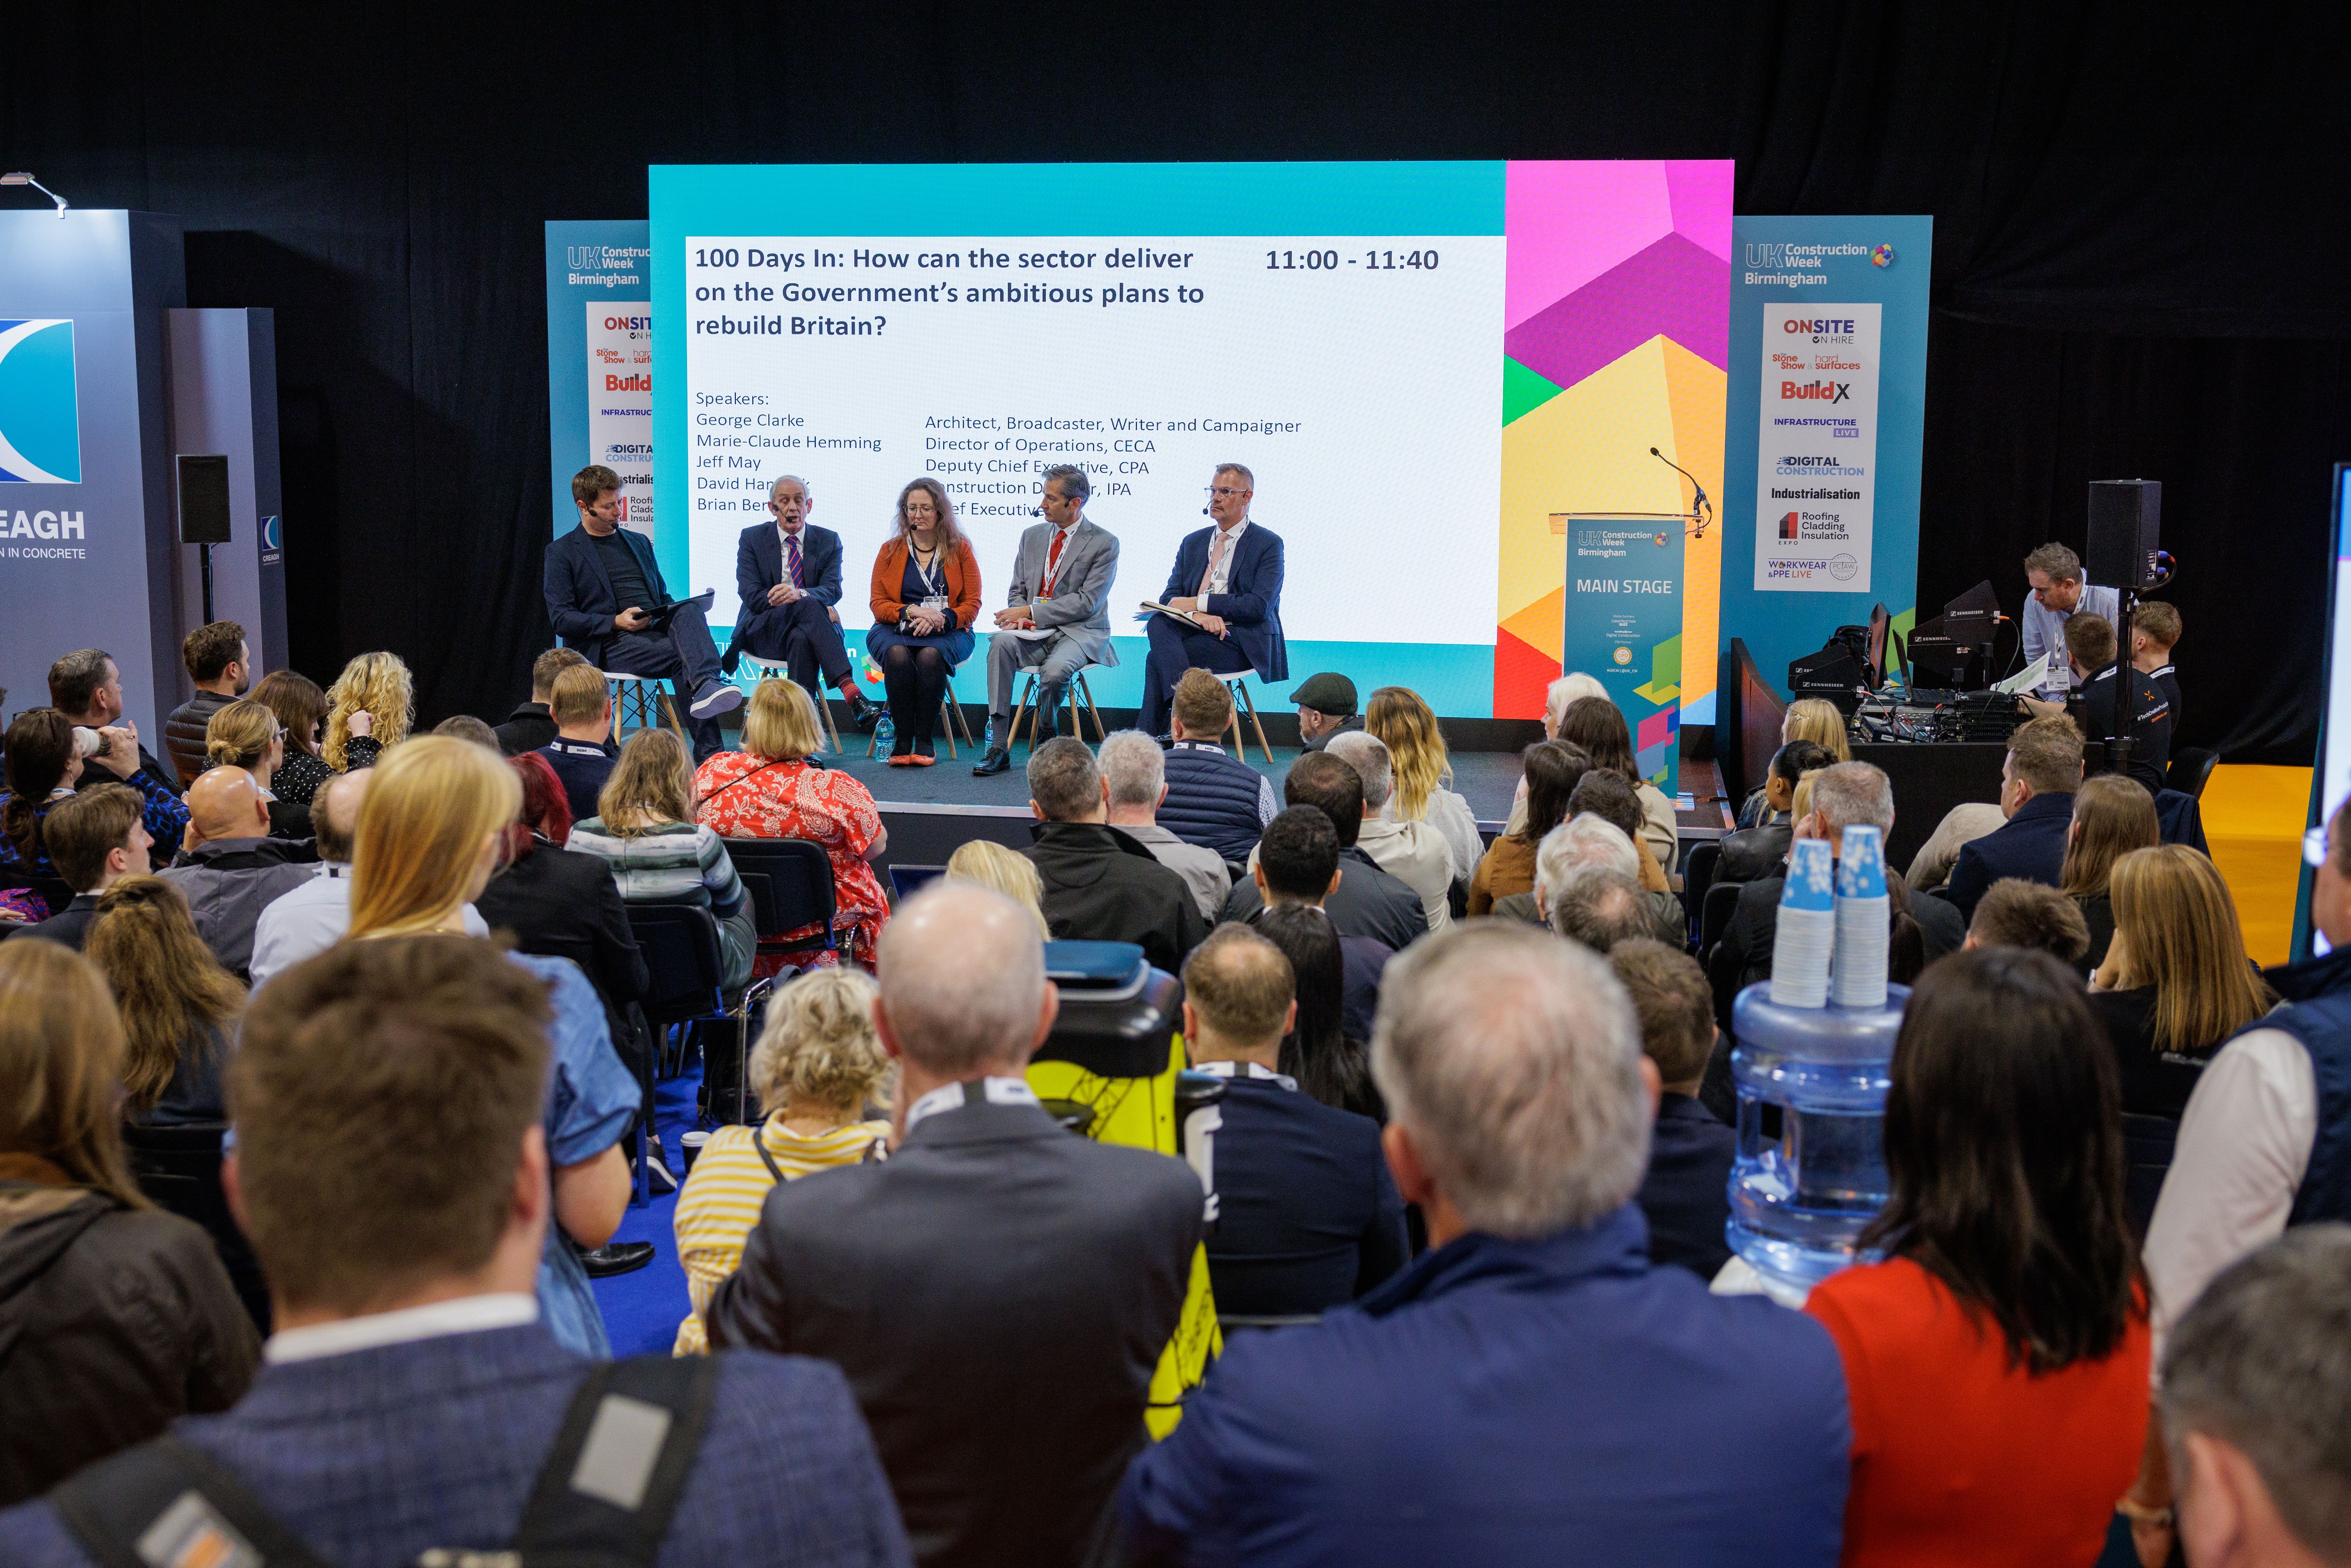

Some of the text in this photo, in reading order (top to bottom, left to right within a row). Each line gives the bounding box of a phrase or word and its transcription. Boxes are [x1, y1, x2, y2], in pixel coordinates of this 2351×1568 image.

[602, 246, 650, 257] Construc
[1746, 244, 1784, 268] UK
[1785, 244, 1867, 255] Construction
[568, 247, 601, 269] UK
[602, 258, 634, 268] Week
[696, 248, 1193, 272] 100 Days In: How can the sector deliver
[1267, 250, 1338, 269] 11:00
[1367, 250, 1438, 270] 11:40
[1785, 256, 1822, 267] Week
[569, 273, 639, 288] Birmingham
[1745, 273, 1827, 288] Birmingham
[696, 282, 1203, 307] on the Government’s ambitious plans to
[605, 317, 651, 330] ONSIT
[697, 315, 886, 335] rebuild Britain?
[1784, 320, 1854, 334] ONSITE
[1781, 361, 1805, 370] Show
[1815, 361, 1860, 370] surfaces
[606, 374, 651, 392] Build
[696, 392, 769, 405] Speakers:
[697, 414, 804, 428] George Clarke
[925, 416, 1301, 434] Architect, Broadcaster, Writer and Campaigner
[615, 445, 653, 453] DIGITA
[698, 435, 881, 452] Marie-Claude Hemming
[926, 437, 1155, 454] Director of Operations, CECA
[697, 455, 761, 471] Jeff May
[926, 459, 1149, 475] Deputy Chief Extive, CPA
[1787, 457, 1839, 466] DIGITAL
[1776, 467, 1864, 476] CONSTRUCTION
[698, 478, 739, 489] David
[1108, 483, 1131, 496] IPA
[1772, 488, 1860, 499] Industrialisation
[698, 498, 736, 511] Brian
[1802, 512, 1839, 522] Roofing
[1802, 522, 1845, 532] Cladding
[1578, 531, 1602, 545] UK
[1802, 532, 1849, 540] Insulation
[8, 548, 19, 558] IN
[23, 548, 86, 559] CONCRETE
[263, 553, 279, 562] CREAGH
[1578, 549, 1626, 558] Birmingham
[1577, 579, 1672, 594] MAIN STAGE
